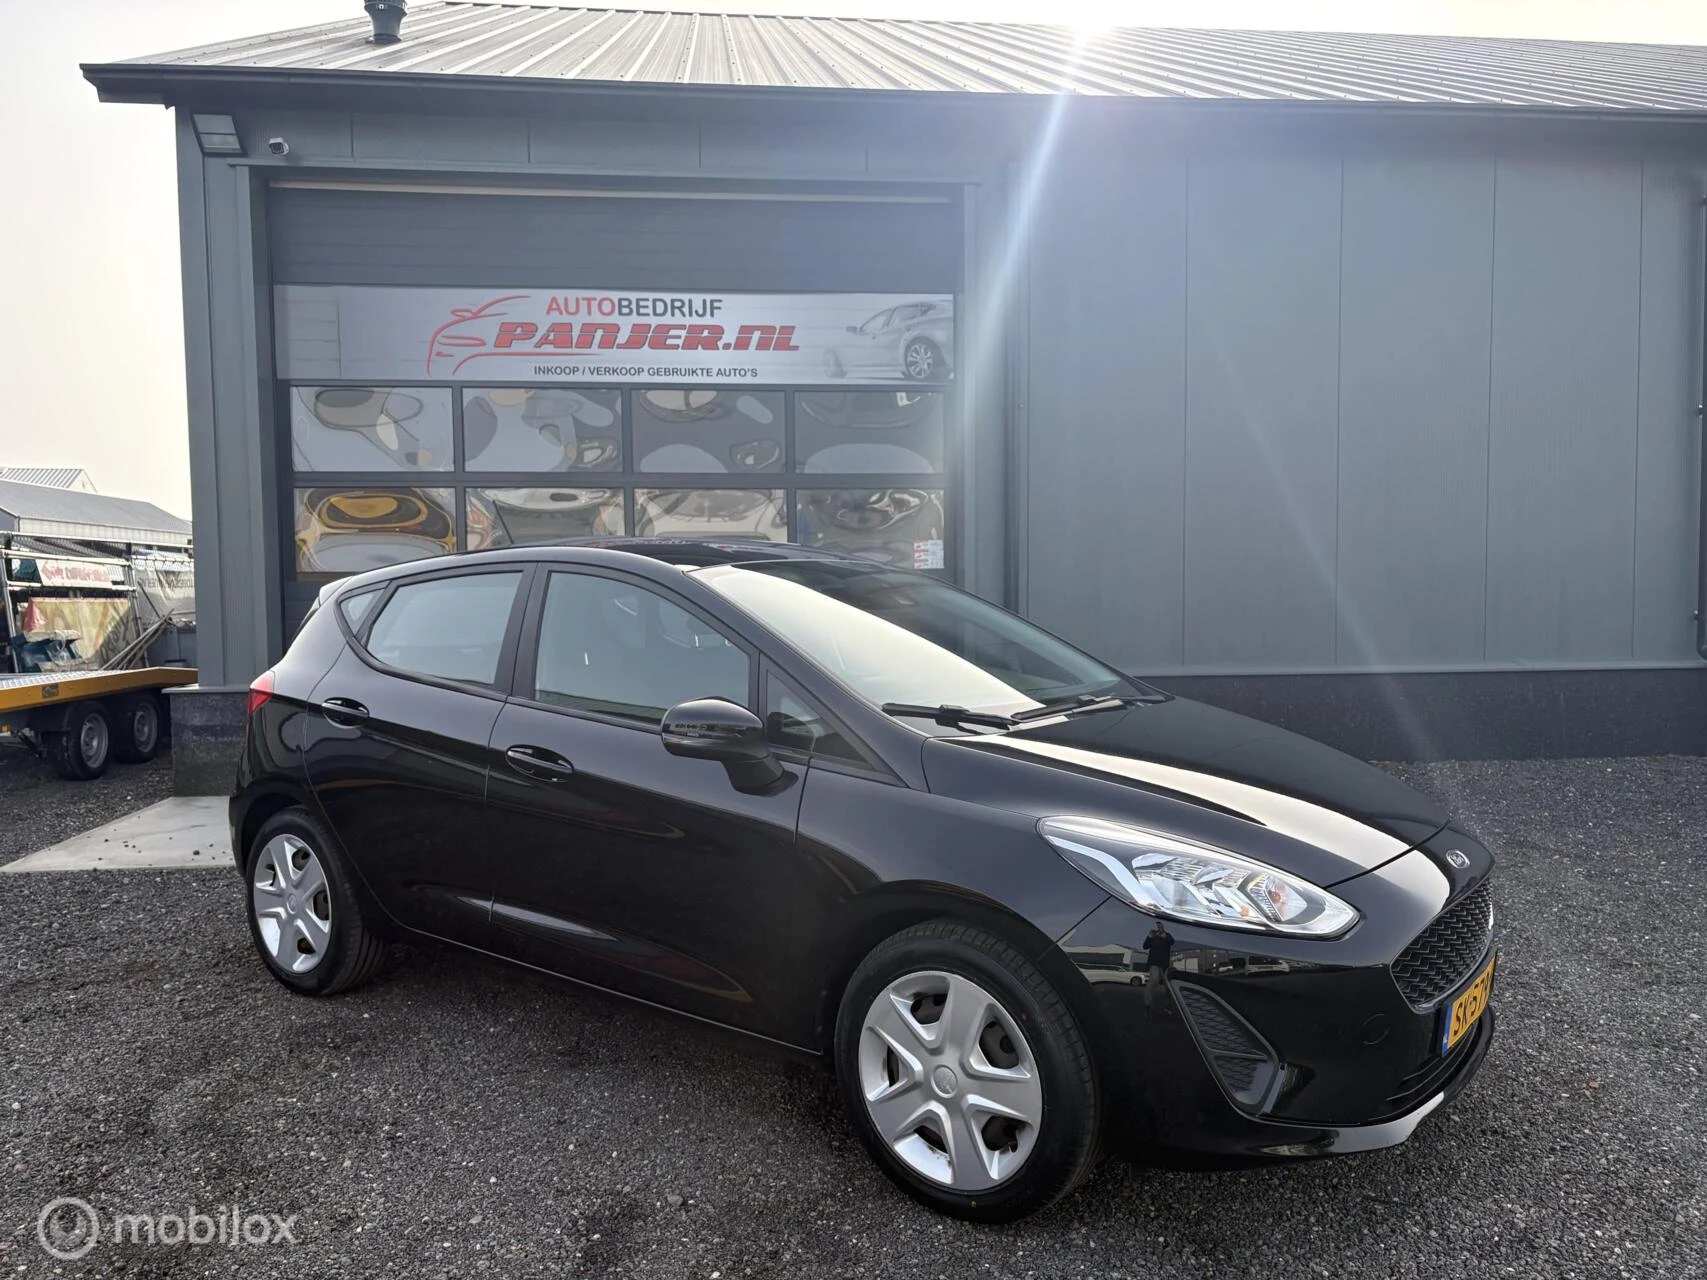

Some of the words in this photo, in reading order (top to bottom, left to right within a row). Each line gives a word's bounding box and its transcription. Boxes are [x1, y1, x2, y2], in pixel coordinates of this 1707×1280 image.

[546, 297, 723, 317] AUTOBEDRIJF
[493, 322, 800, 351] PANJER.NL
[534, 366, 579, 375] INKOOP
[589, 367, 645, 376] VERKOOP
[647, 367, 713, 377] GEBRUIKTE
[716, 368, 758, 377] AUTO'S
